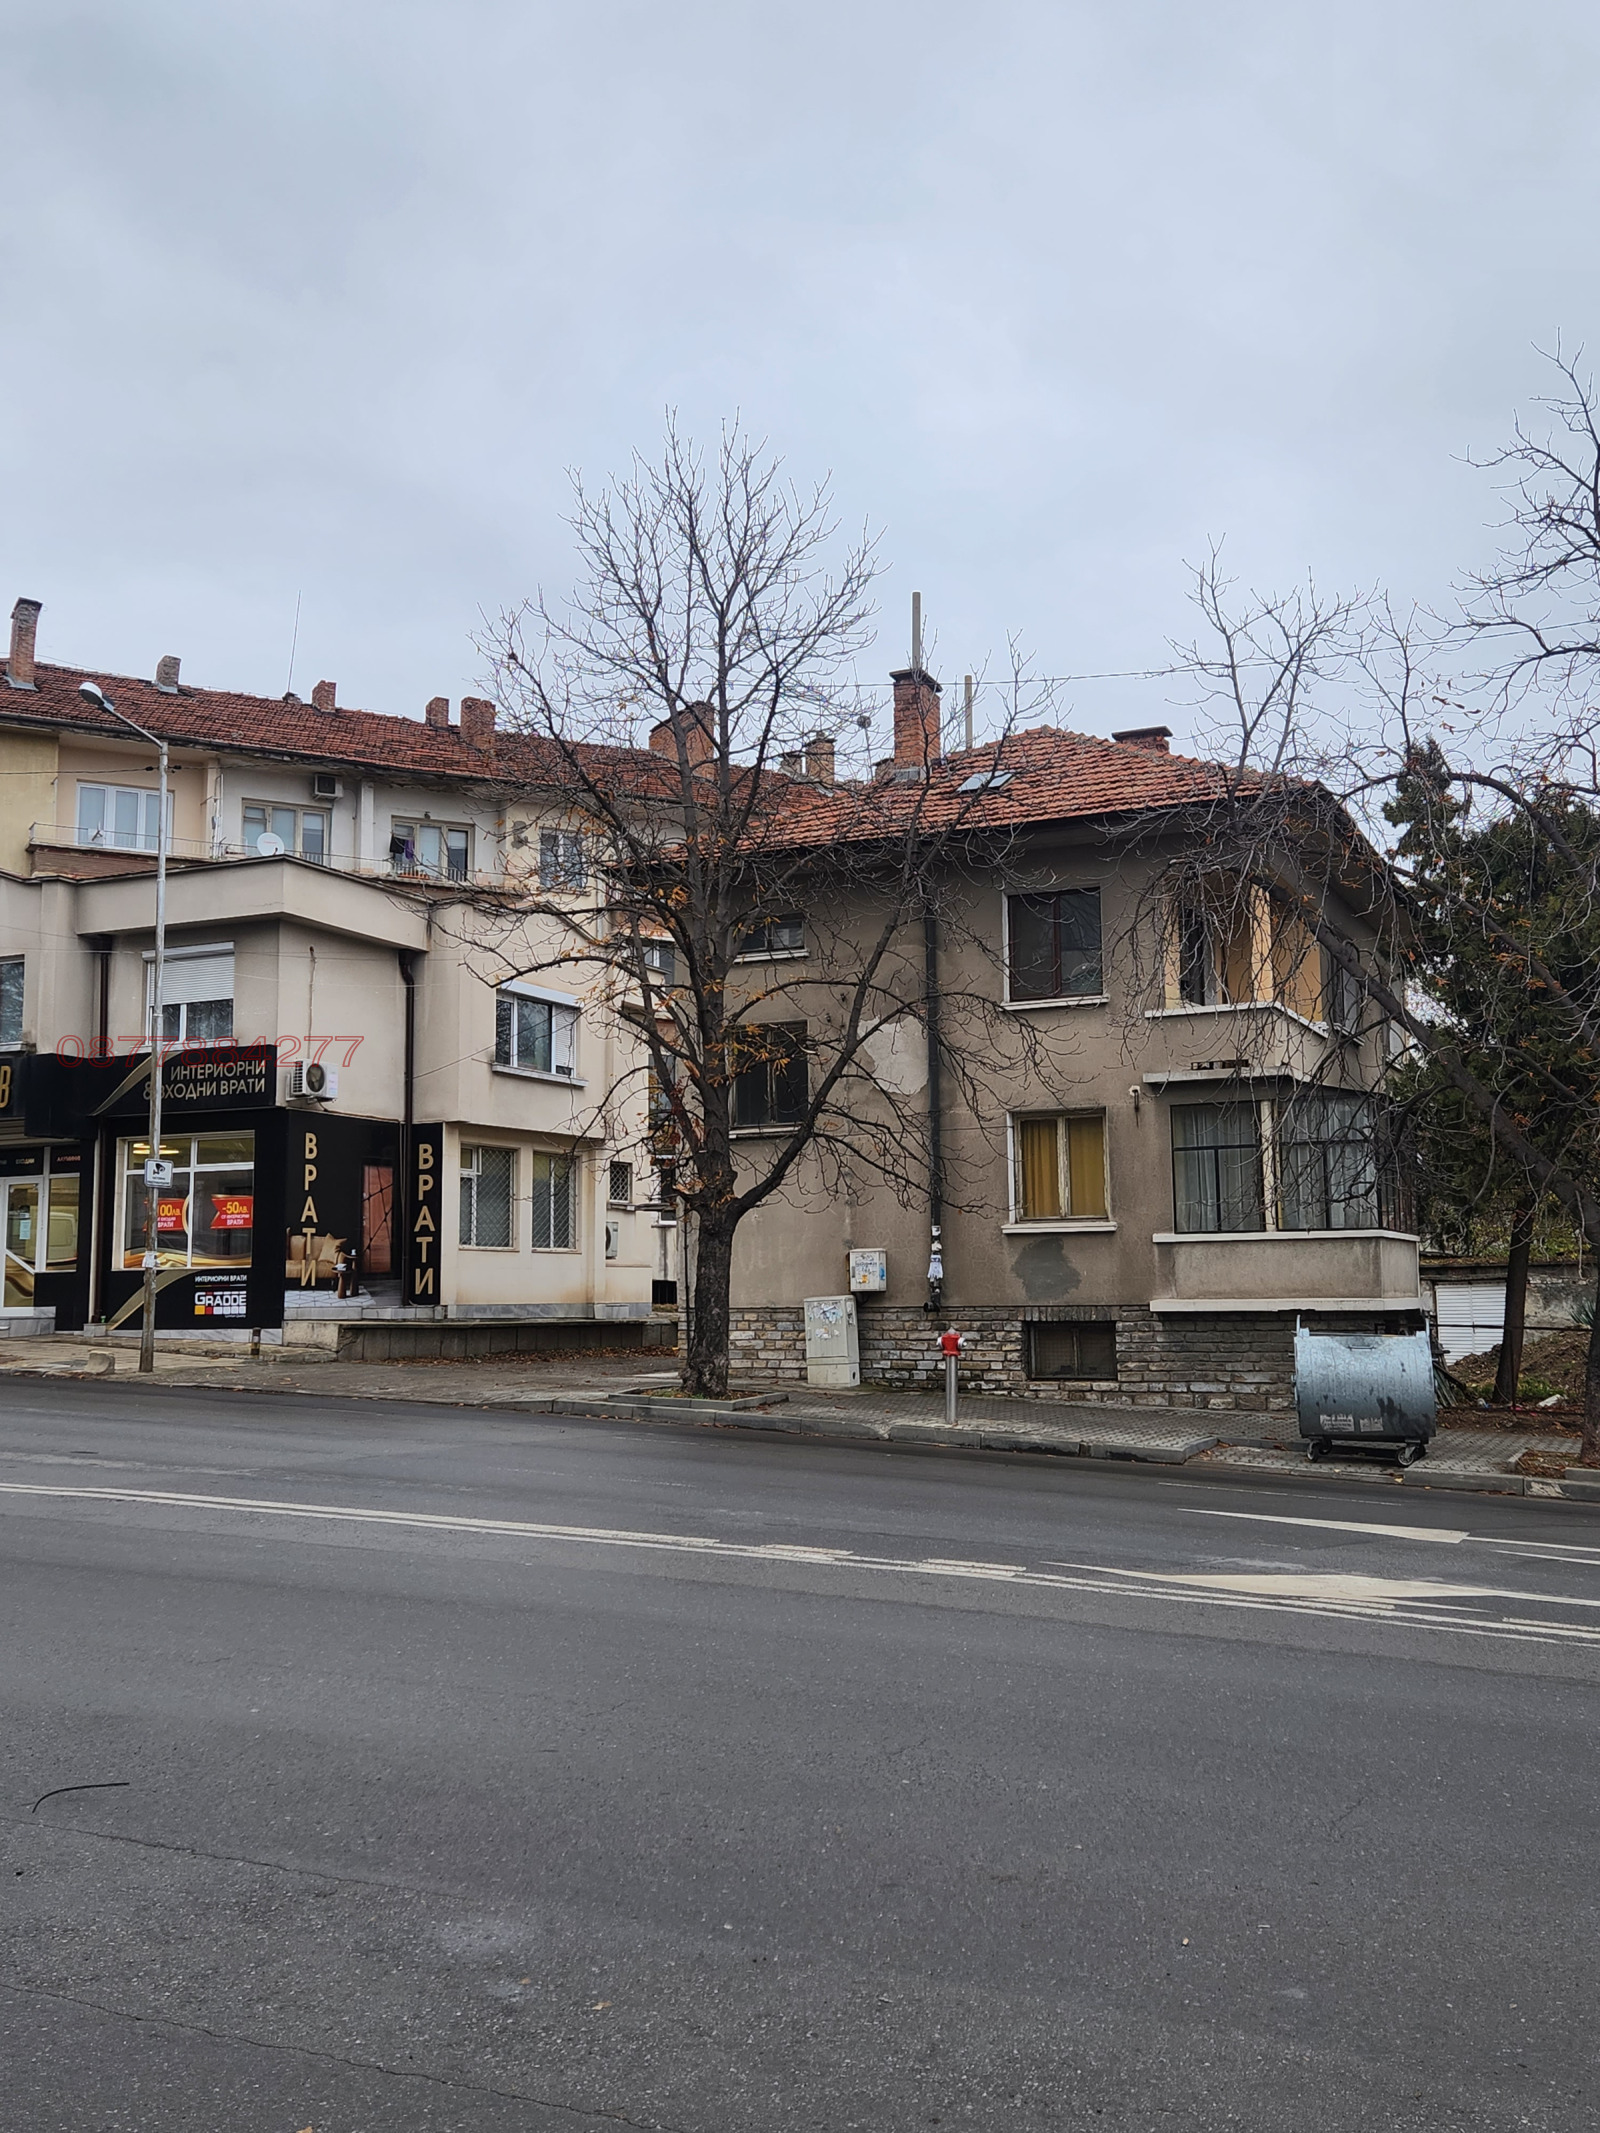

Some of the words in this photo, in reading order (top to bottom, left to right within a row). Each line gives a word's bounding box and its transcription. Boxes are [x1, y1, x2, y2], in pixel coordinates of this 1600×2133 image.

[170, 1060, 266, 1080] ИНТЕРИОРНИ
[220, 1077, 266, 1096] ВРАТИ
[300, 1132, 319, 1287] ВРАТИ
[414, 1143, 436, 1295] ВРАТИ
[194, 1275, 230, 1283] ИНТЕРИОРНИ
[230, 1274, 247, 1282] ВРАТИ
